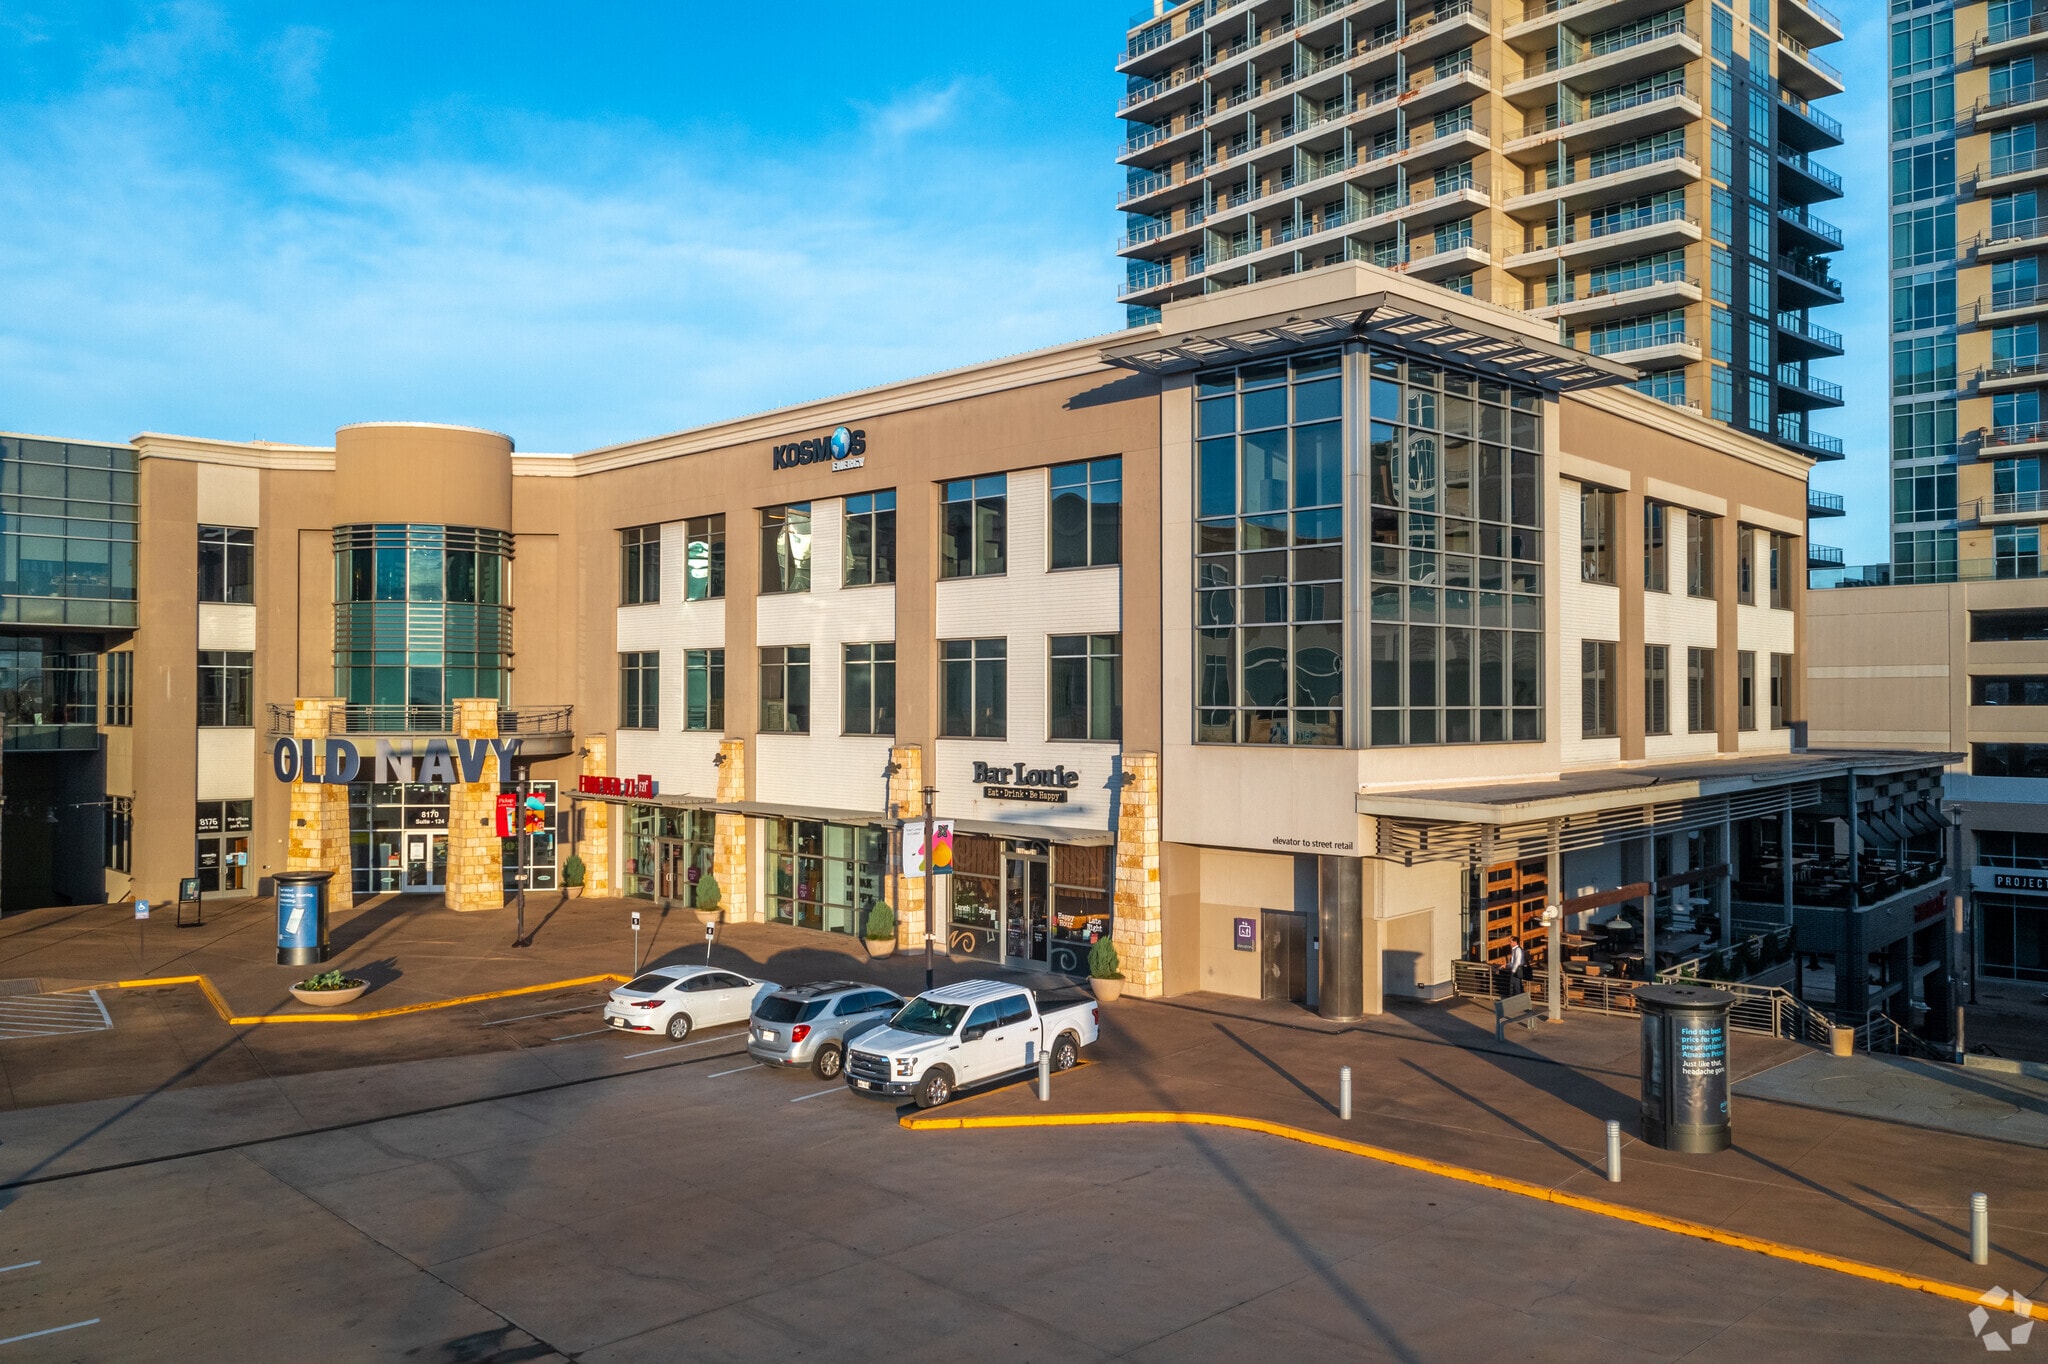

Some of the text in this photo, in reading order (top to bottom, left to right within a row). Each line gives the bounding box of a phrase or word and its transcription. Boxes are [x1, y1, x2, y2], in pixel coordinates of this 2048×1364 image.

[773, 426, 867, 471] KOSMOS
[273, 737, 524, 785] OLD NAVY
[973, 761, 1079, 789] Bar Louie
[987, 788, 1060, 801] Eat Drink Be Happy
[199, 817, 218, 826] 8176
[1272, 836, 1354, 850] elevator to street retail
[1698, 1027, 1710, 1035] the
[1700, 1035, 1710, 1043] for
[1682, 1050, 1710, 1058] Amazon
[1682, 1060, 1697, 1068] Just
[1698, 1060, 1710, 1068] like
[1682, 1067, 1714, 1075] headache
